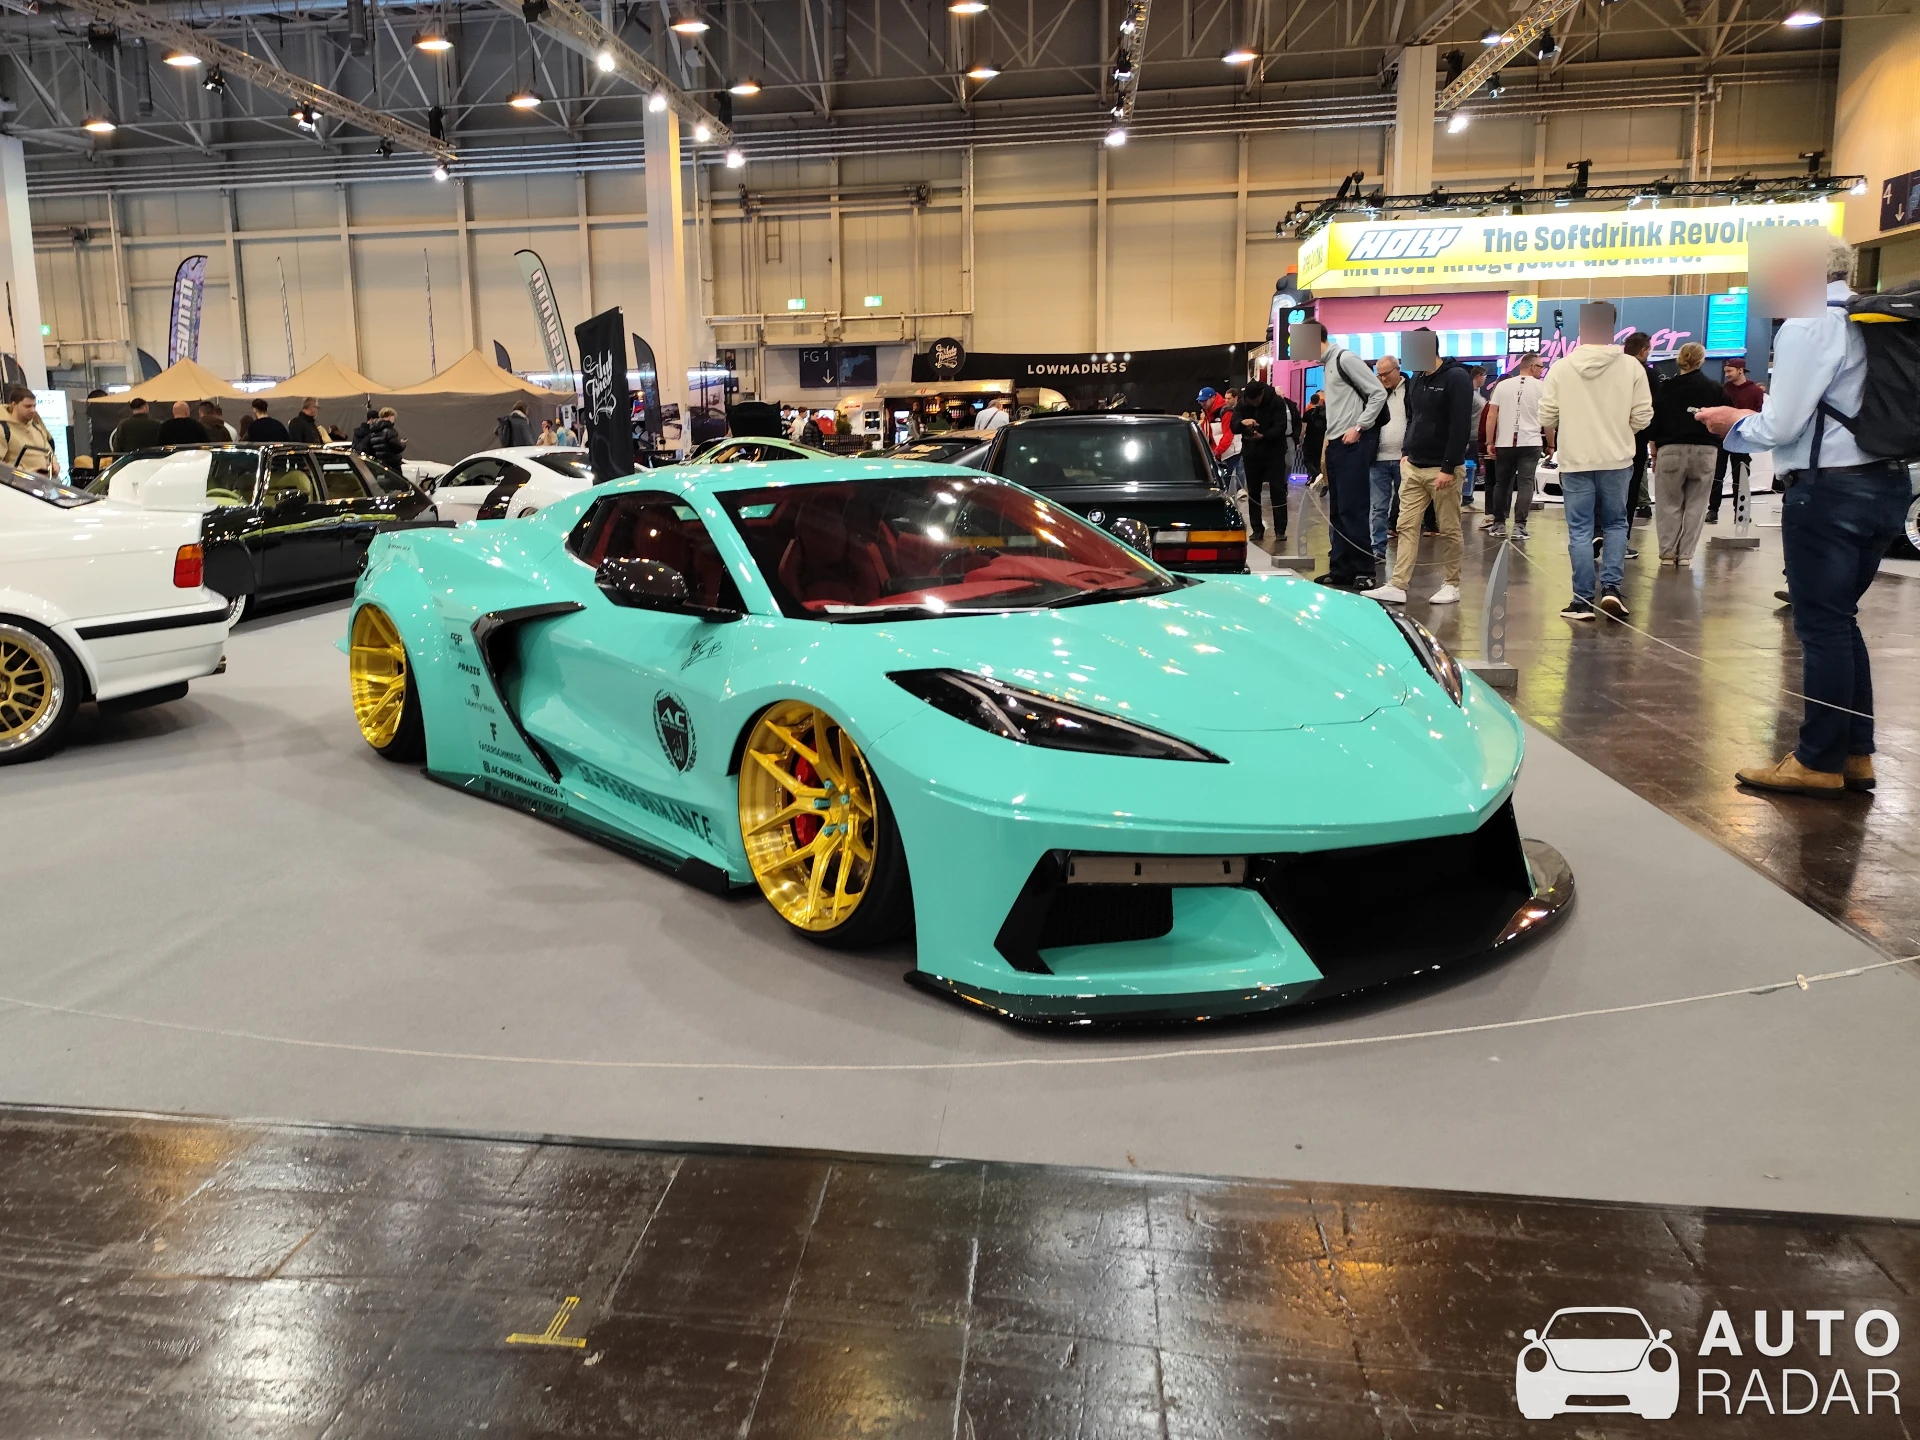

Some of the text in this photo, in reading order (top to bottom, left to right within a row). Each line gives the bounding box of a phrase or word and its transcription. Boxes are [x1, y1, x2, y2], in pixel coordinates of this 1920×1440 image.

[1883, 183, 1892, 205] 4
[1346, 226, 1463, 261] HOLY
[1484, 228, 1527, 253] The
[1535, 221, 1663, 251] Softdrink
[1384, 304, 1443, 323] HOLY
[803, 350, 829, 363] FG 1
[1027, 362, 1127, 375] LOWMADNESS
[661, 707, 685, 728] AC
